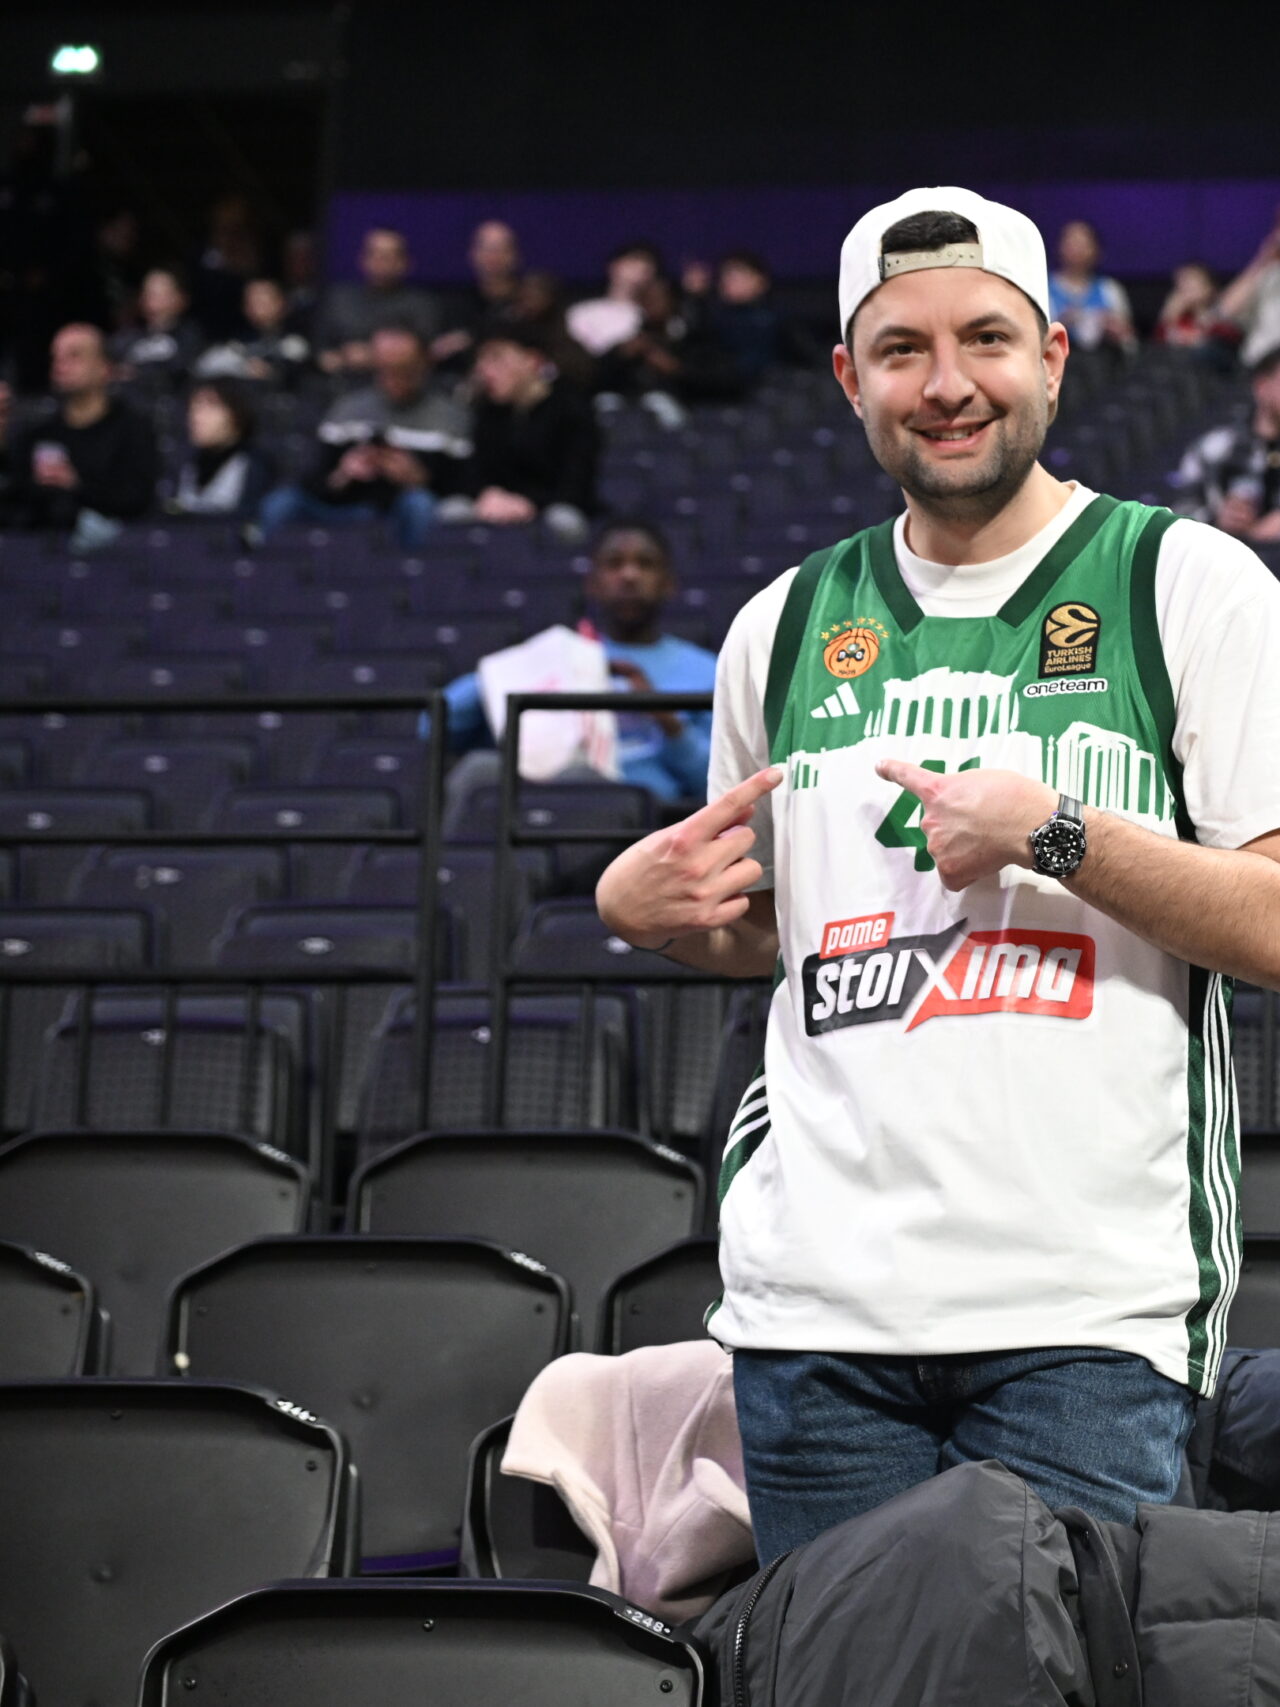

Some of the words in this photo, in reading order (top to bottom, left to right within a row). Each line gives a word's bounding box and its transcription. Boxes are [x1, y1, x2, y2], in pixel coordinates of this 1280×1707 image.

[1047, 646, 1093, 658] TURKISH
[1045, 654, 1092, 666] AIRLINES
[1044, 662, 1092, 674] EuroLeague
[1026, 679, 1106, 696] oneteam
[825, 917, 889, 955] pame
[631, 1610, 665, 1633] 248
